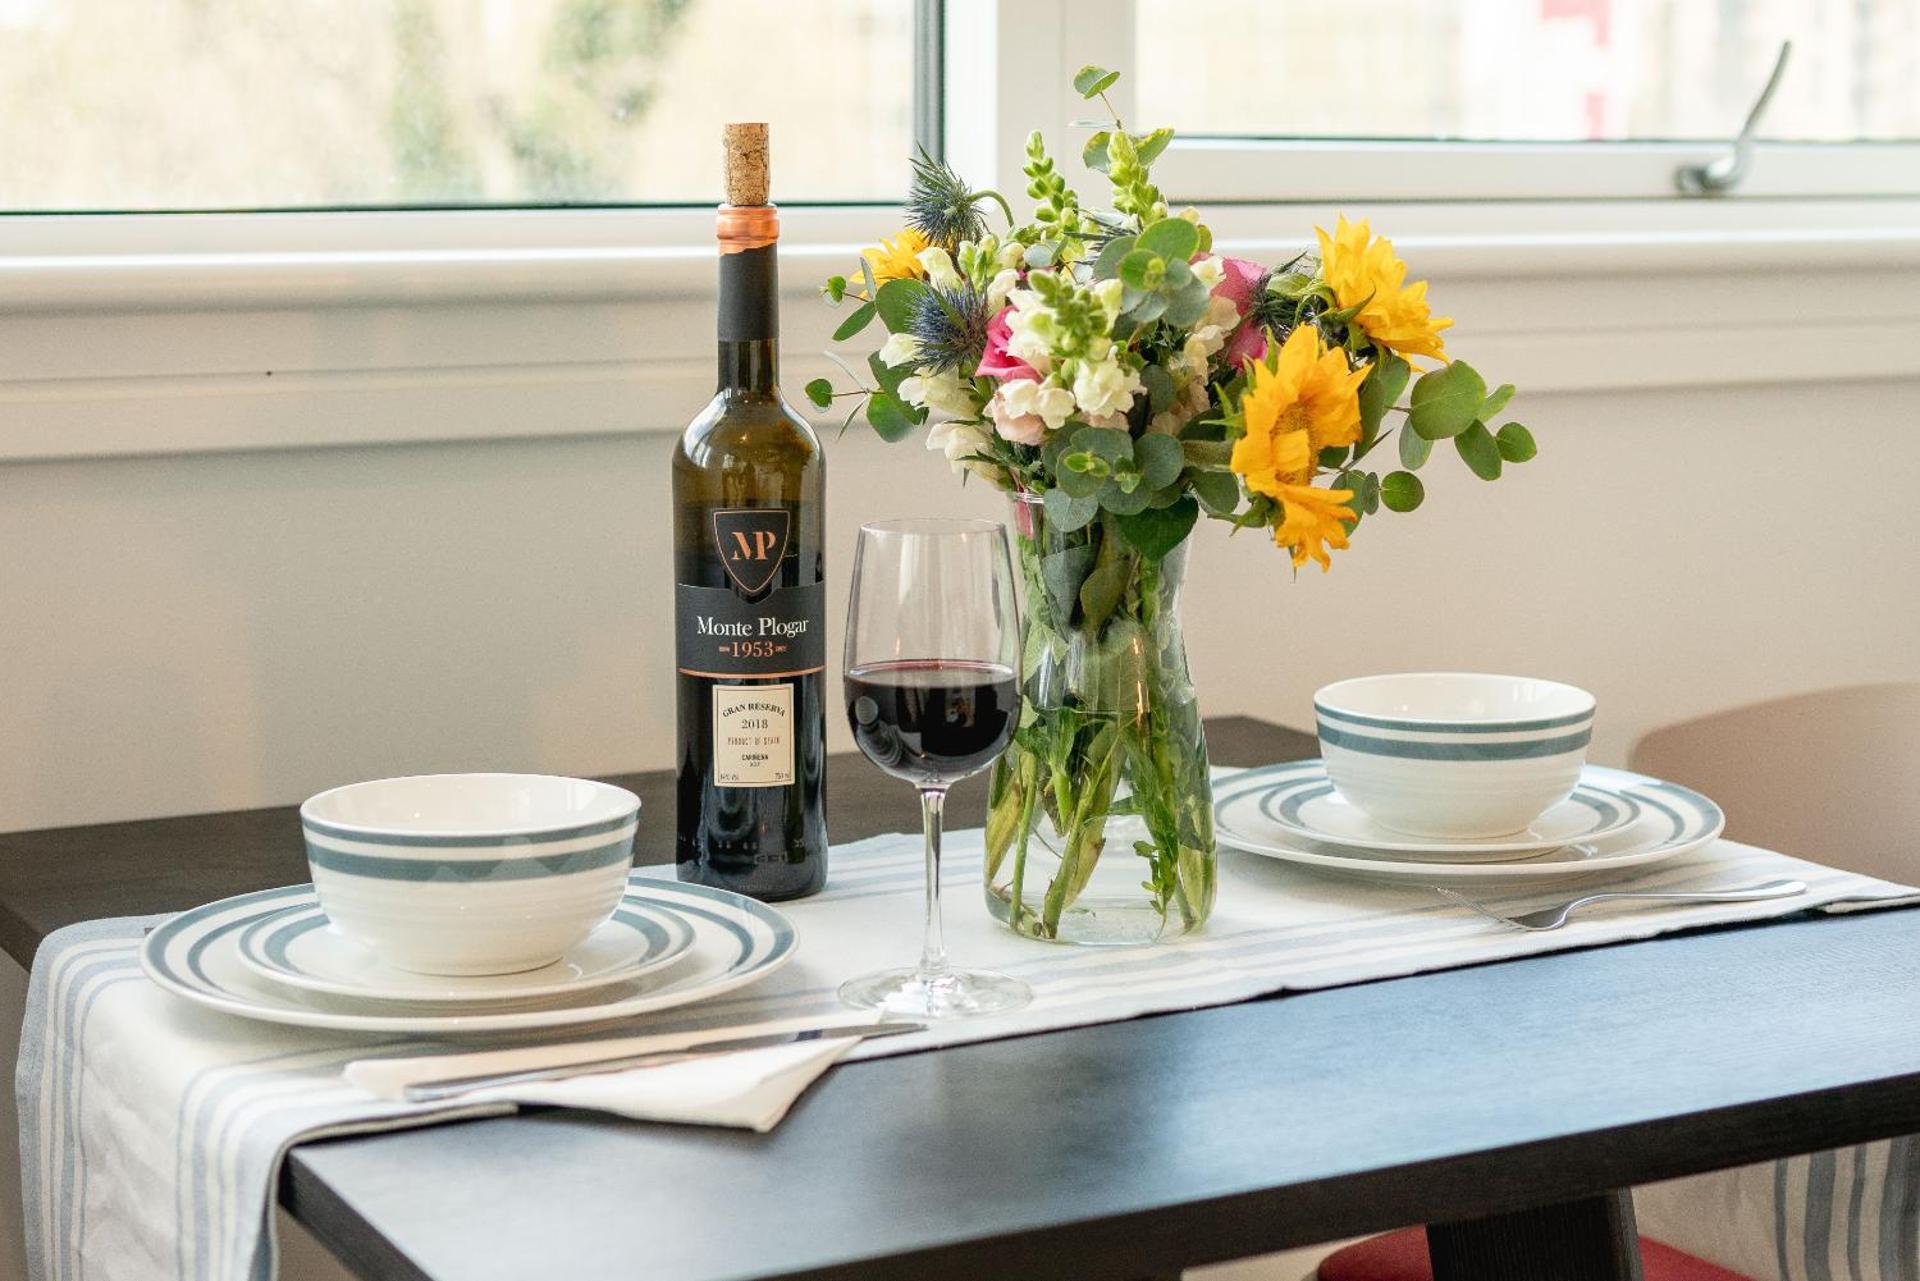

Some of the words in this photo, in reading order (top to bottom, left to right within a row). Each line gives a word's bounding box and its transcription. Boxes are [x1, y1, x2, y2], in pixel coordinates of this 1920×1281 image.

[731, 531, 776, 560] MP
[697, 616, 752, 637] Monte
[758, 617, 809, 638] Plogar
[731, 641, 774, 658] 1953
[722, 703, 746, 718] GRAN
[748, 703, 786, 717] RESERVA
[741, 719, 769, 729] 2018
